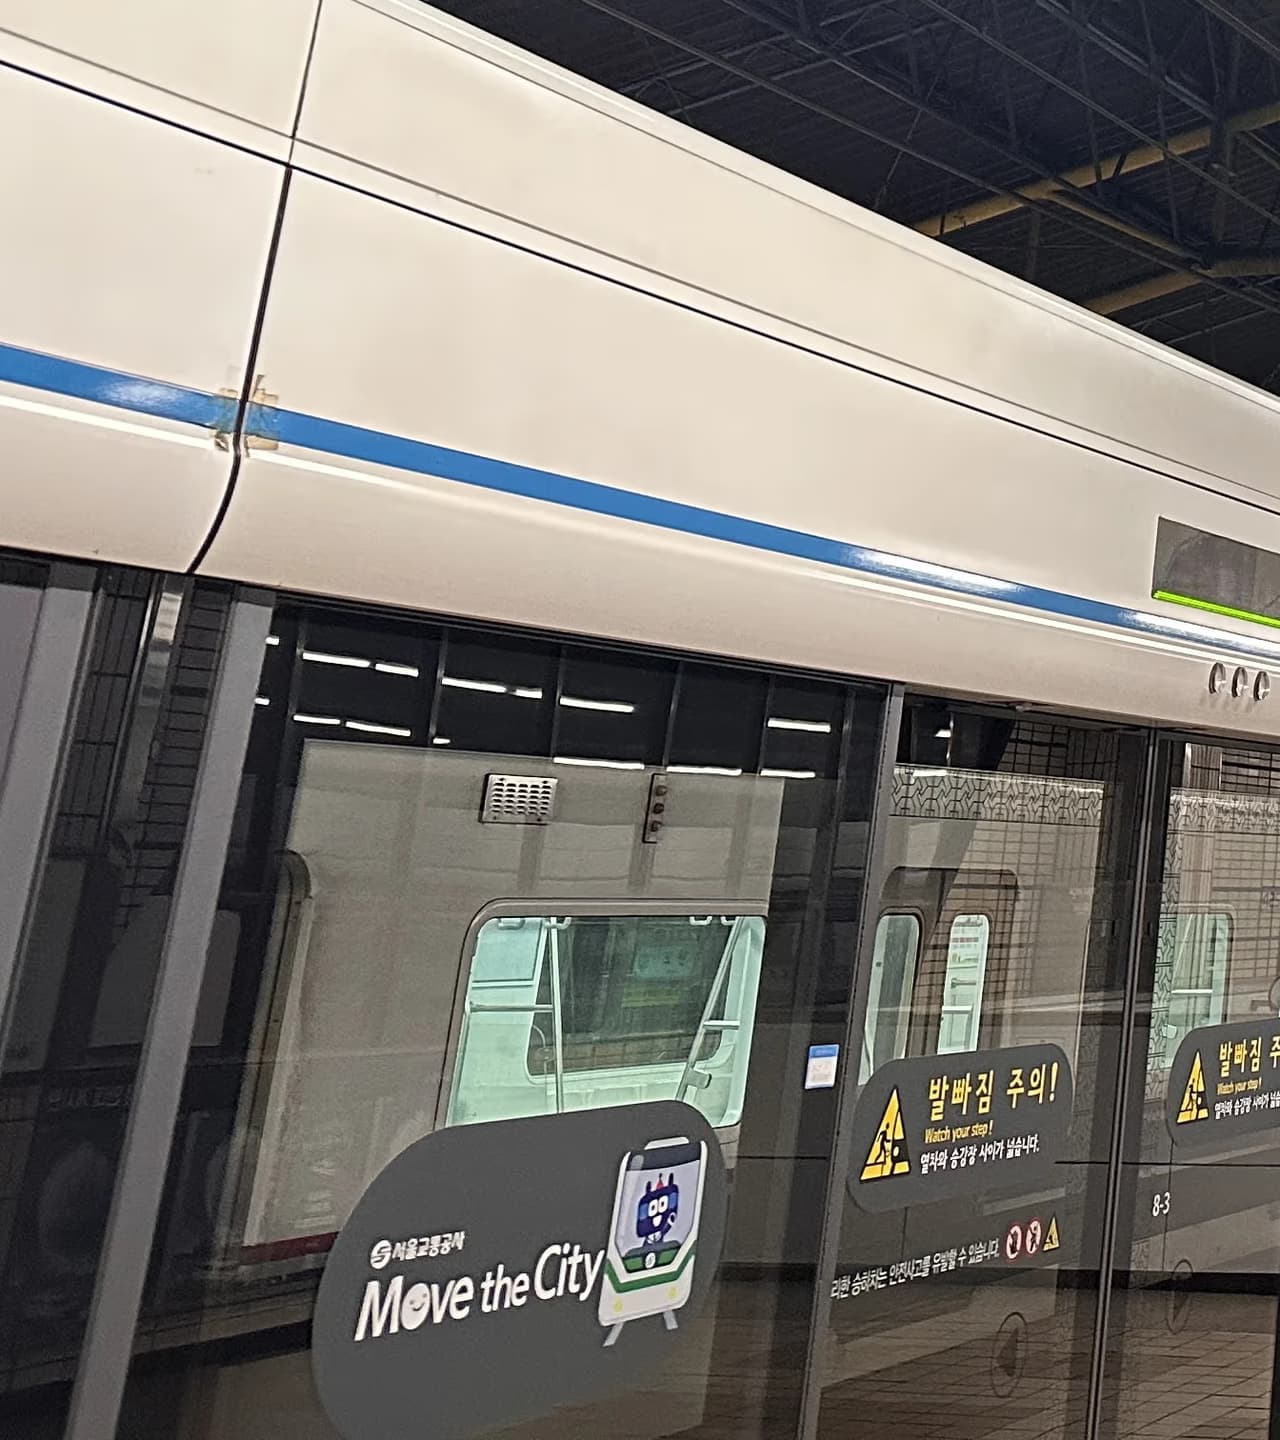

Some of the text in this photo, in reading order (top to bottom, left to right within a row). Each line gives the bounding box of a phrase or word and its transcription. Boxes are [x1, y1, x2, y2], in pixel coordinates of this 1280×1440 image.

[1219, 1036, 1262, 1078] 발빠짐
[928, 1061, 1059, 1122] 발빠짐 주의!
[1234, 1081, 1247, 1095] your
[1214, 1099, 1233, 1120] 열차와
[1233, 1095, 1252, 1116] 승강장
[1252, 1092, 1270, 1111] 사이가
[924, 1126, 951, 1144] Watch
[951, 1124, 970, 1143] your
[920, 1133, 1040, 1175] 열차와 승강장 사이가 넓습니다.
[1152, 1191, 1171, 1217] 8-3
[392, 1231, 465, 1261] 서울교통공사
[957, 1248, 967, 1267] 수
[354, 1242, 606, 1342] Move the City
